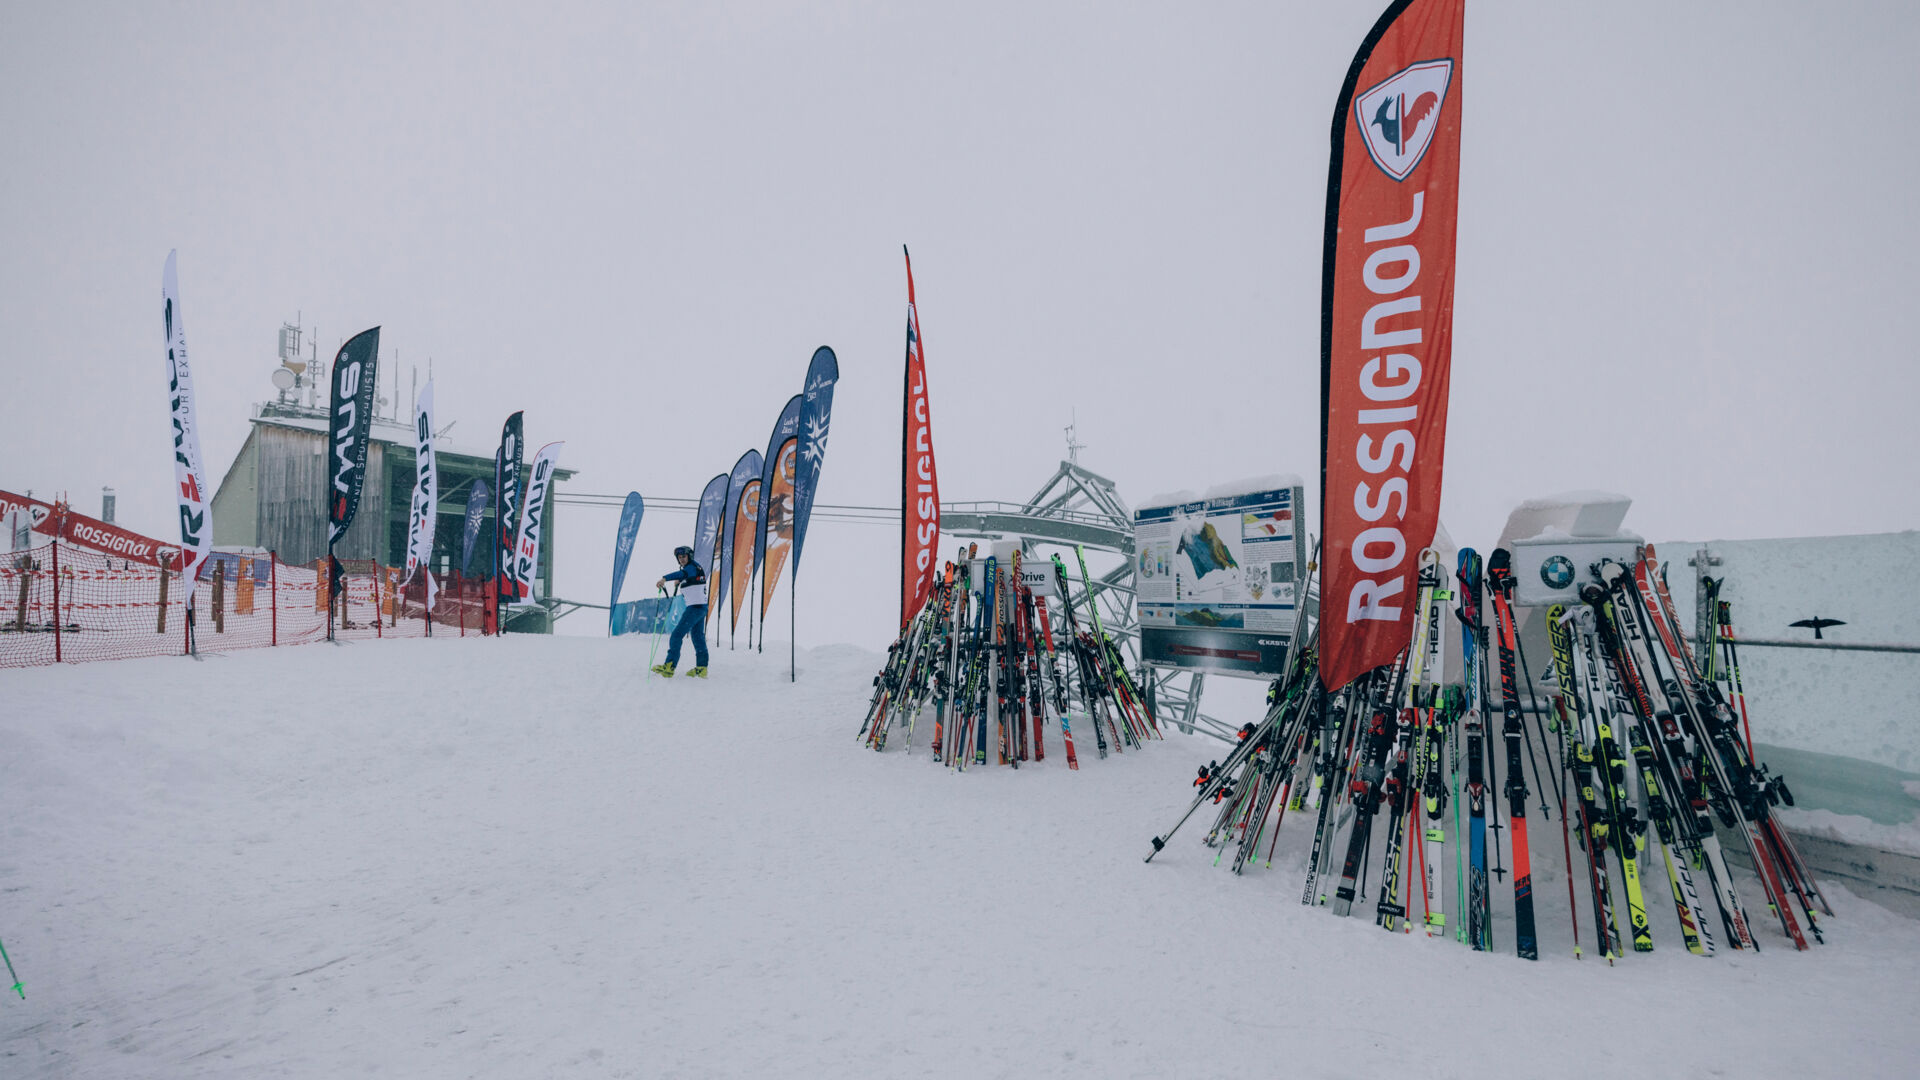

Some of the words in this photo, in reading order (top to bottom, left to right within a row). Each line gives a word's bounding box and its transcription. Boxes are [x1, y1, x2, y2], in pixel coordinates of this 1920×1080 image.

[1346, 190, 1426, 626] ROSSIGNOL
[73, 522, 153, 561] ROSSIGNOL
[502, 433, 516, 580] REMUS
[517, 458, 550, 583] REMUS
[1430, 605, 1439, 654] HEAD
[1550, 619, 1577, 713] FISCHER
[1583, 633, 1601, 692] HEAD
